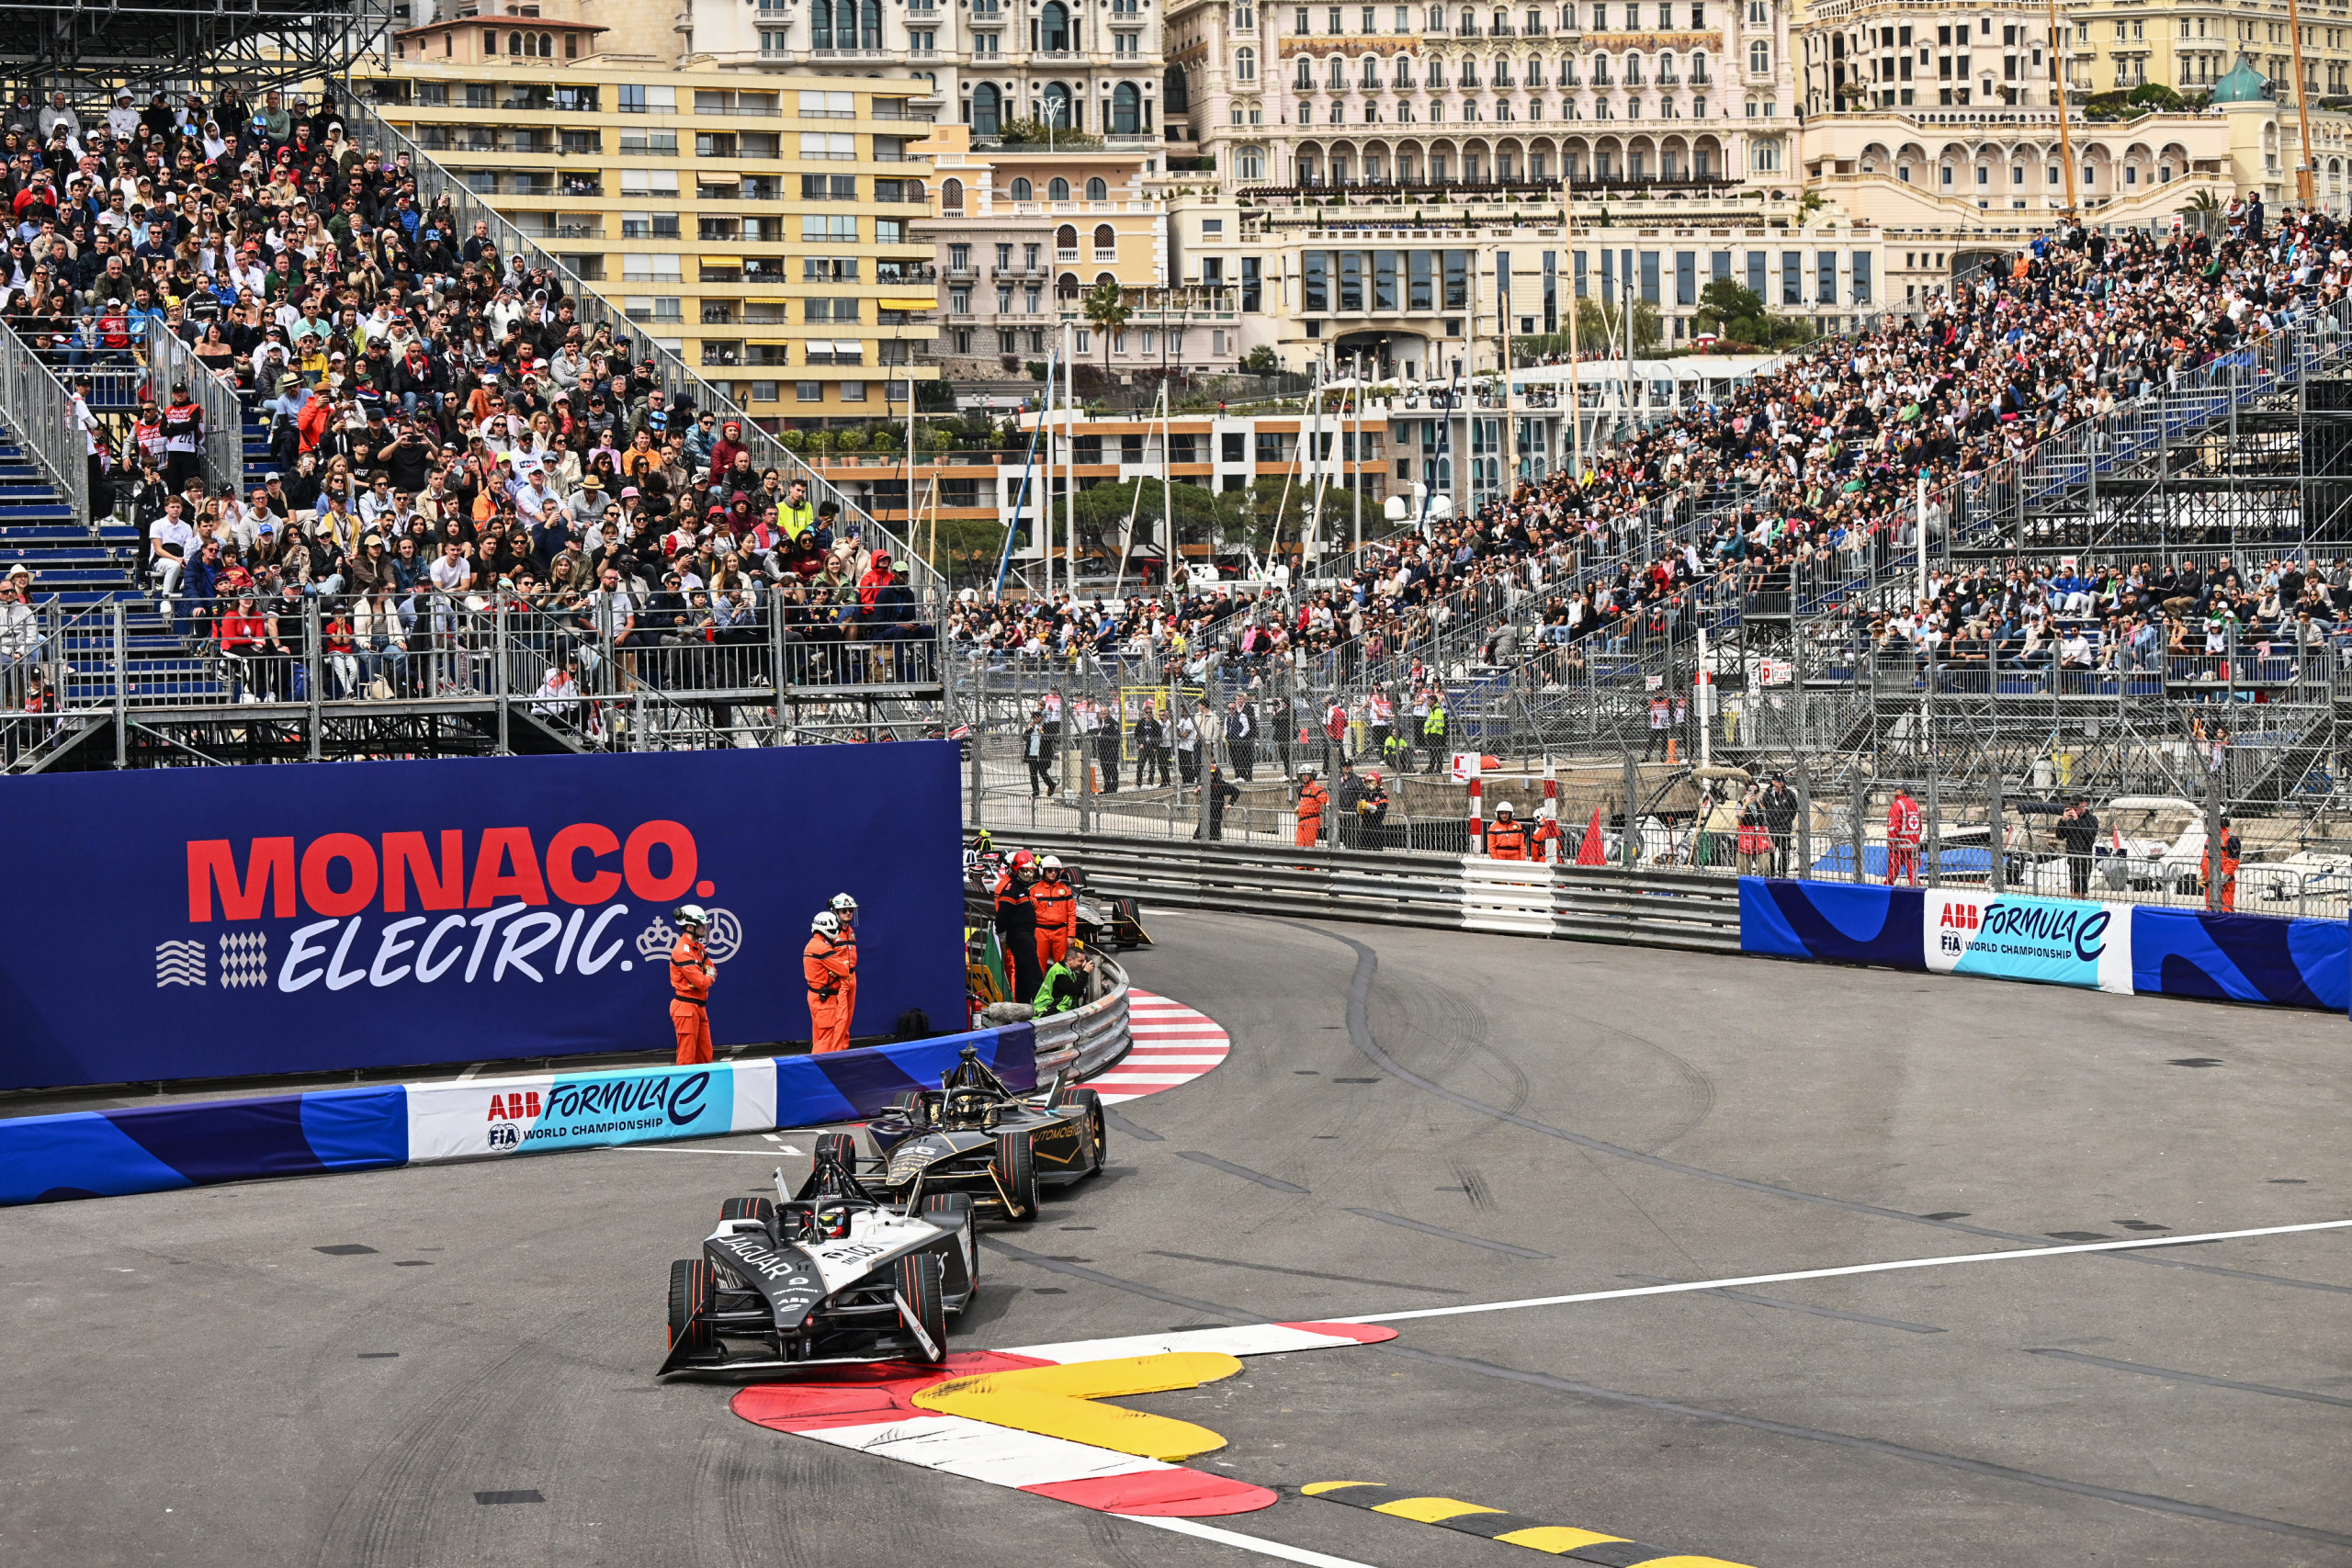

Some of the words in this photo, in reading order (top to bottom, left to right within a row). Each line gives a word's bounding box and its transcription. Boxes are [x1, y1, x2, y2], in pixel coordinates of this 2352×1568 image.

[1763, 667, 1770, 682] P
[187, 819, 716, 923] MONACO.
[1939, 902, 1979, 930] ABB
[1980, 903, 2078, 943] FORMULA
[277, 901, 633, 993] ELECTRIC.
[1965, 941, 1997, 953] WORLD
[2001, 944, 2072, 960] CHAMPIONSHIP
[487, 1091, 542, 1122] ABB
[545, 1076, 671, 1121] FORMULA
[524, 1126, 567, 1140] WORLD
[571, 1117, 663, 1136] CHAMPIONSHIP
[895, 1145, 937, 1157] 25
[717, 1236, 793, 1281] JAGUAR
[841, 1256, 863, 1266] TATA
[777, 1297, 809, 1305] ABB
